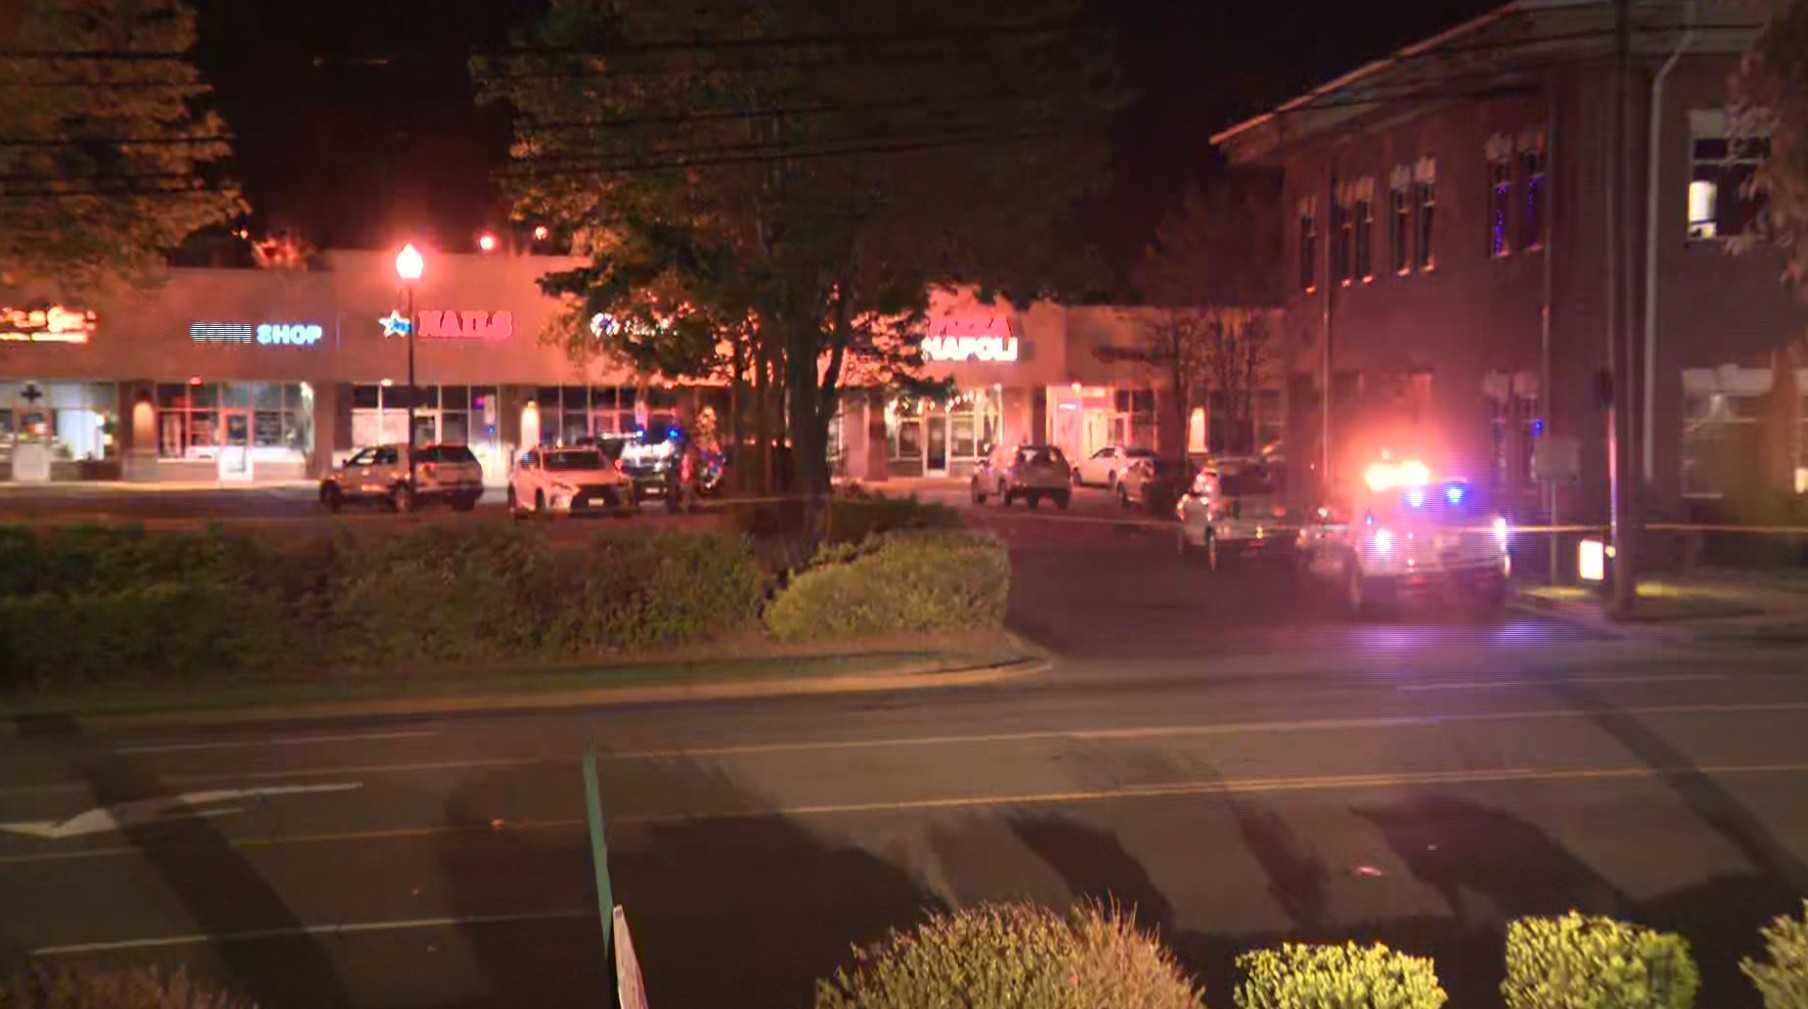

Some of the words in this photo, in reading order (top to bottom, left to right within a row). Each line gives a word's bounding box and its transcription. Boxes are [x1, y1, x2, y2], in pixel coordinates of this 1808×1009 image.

[190, 321, 251, 344] COIN
[257, 323, 323, 345] SHOP
[417, 309, 513, 338] NAILS
[921, 336, 1018, 361] NAPOLI
